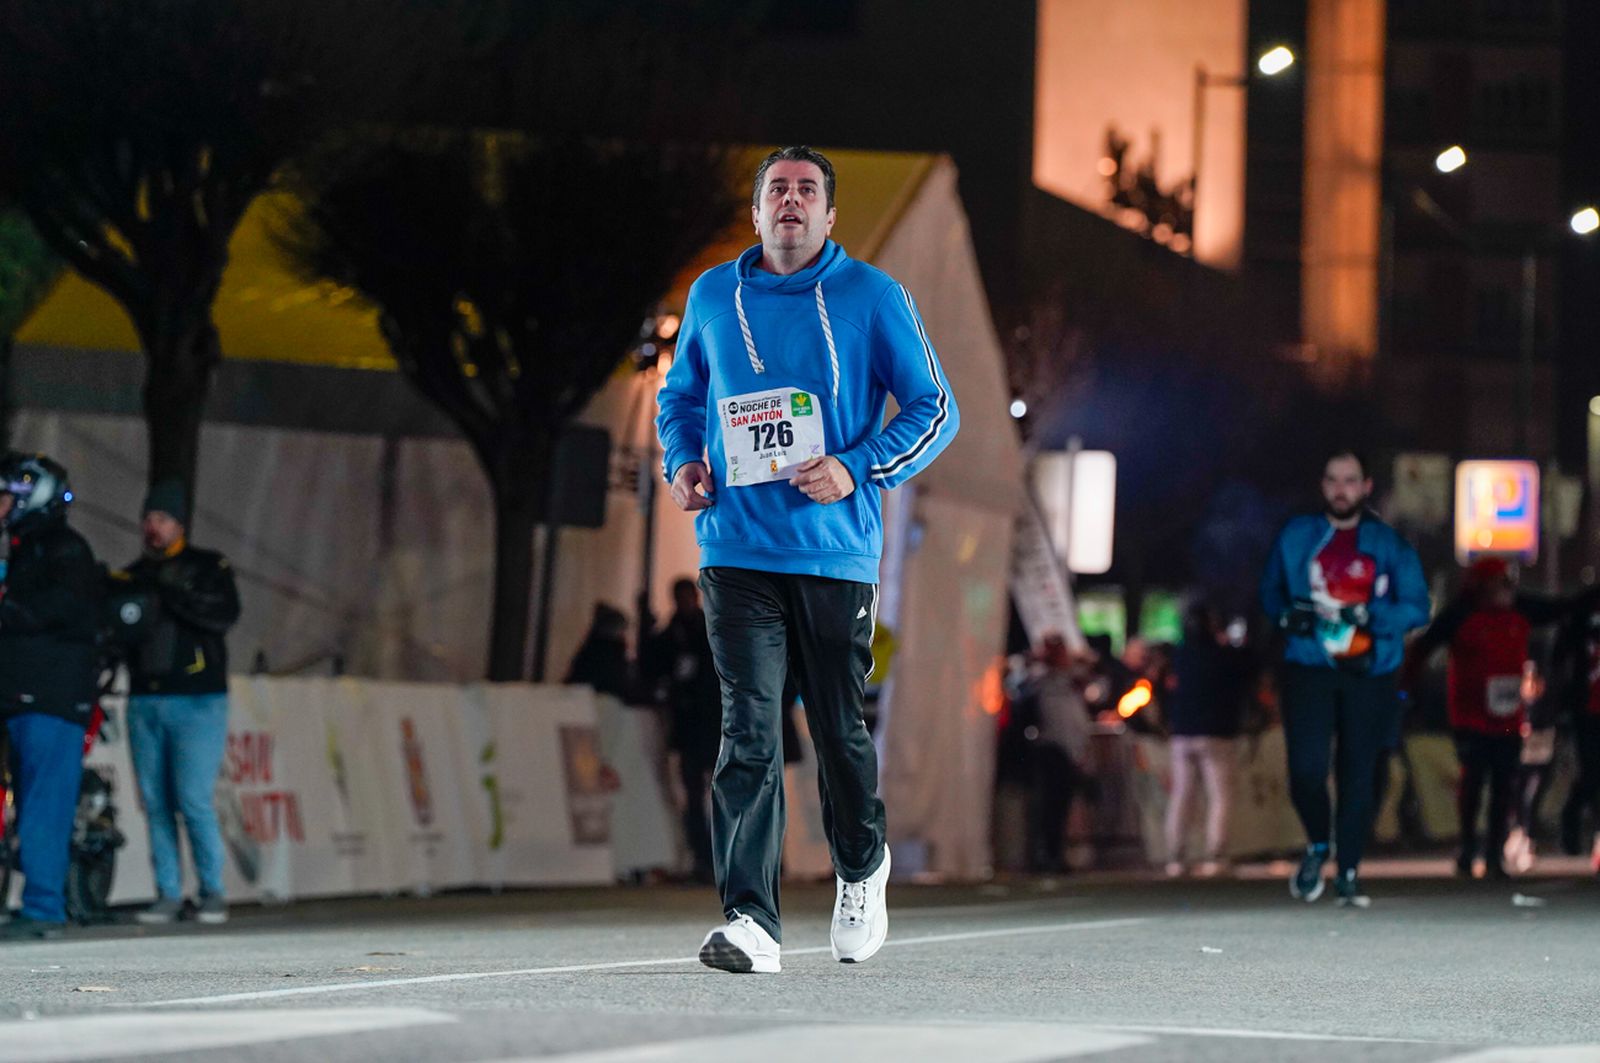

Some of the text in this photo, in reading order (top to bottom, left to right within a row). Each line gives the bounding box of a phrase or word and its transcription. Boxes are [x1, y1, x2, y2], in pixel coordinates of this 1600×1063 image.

[739, 401, 769, 414] NOCHE
[770, 398, 782, 408] DE
[730, 415, 749, 428] SAN
[750, 407, 783, 423] ANTÓN
[748, 420, 794, 452] 726
